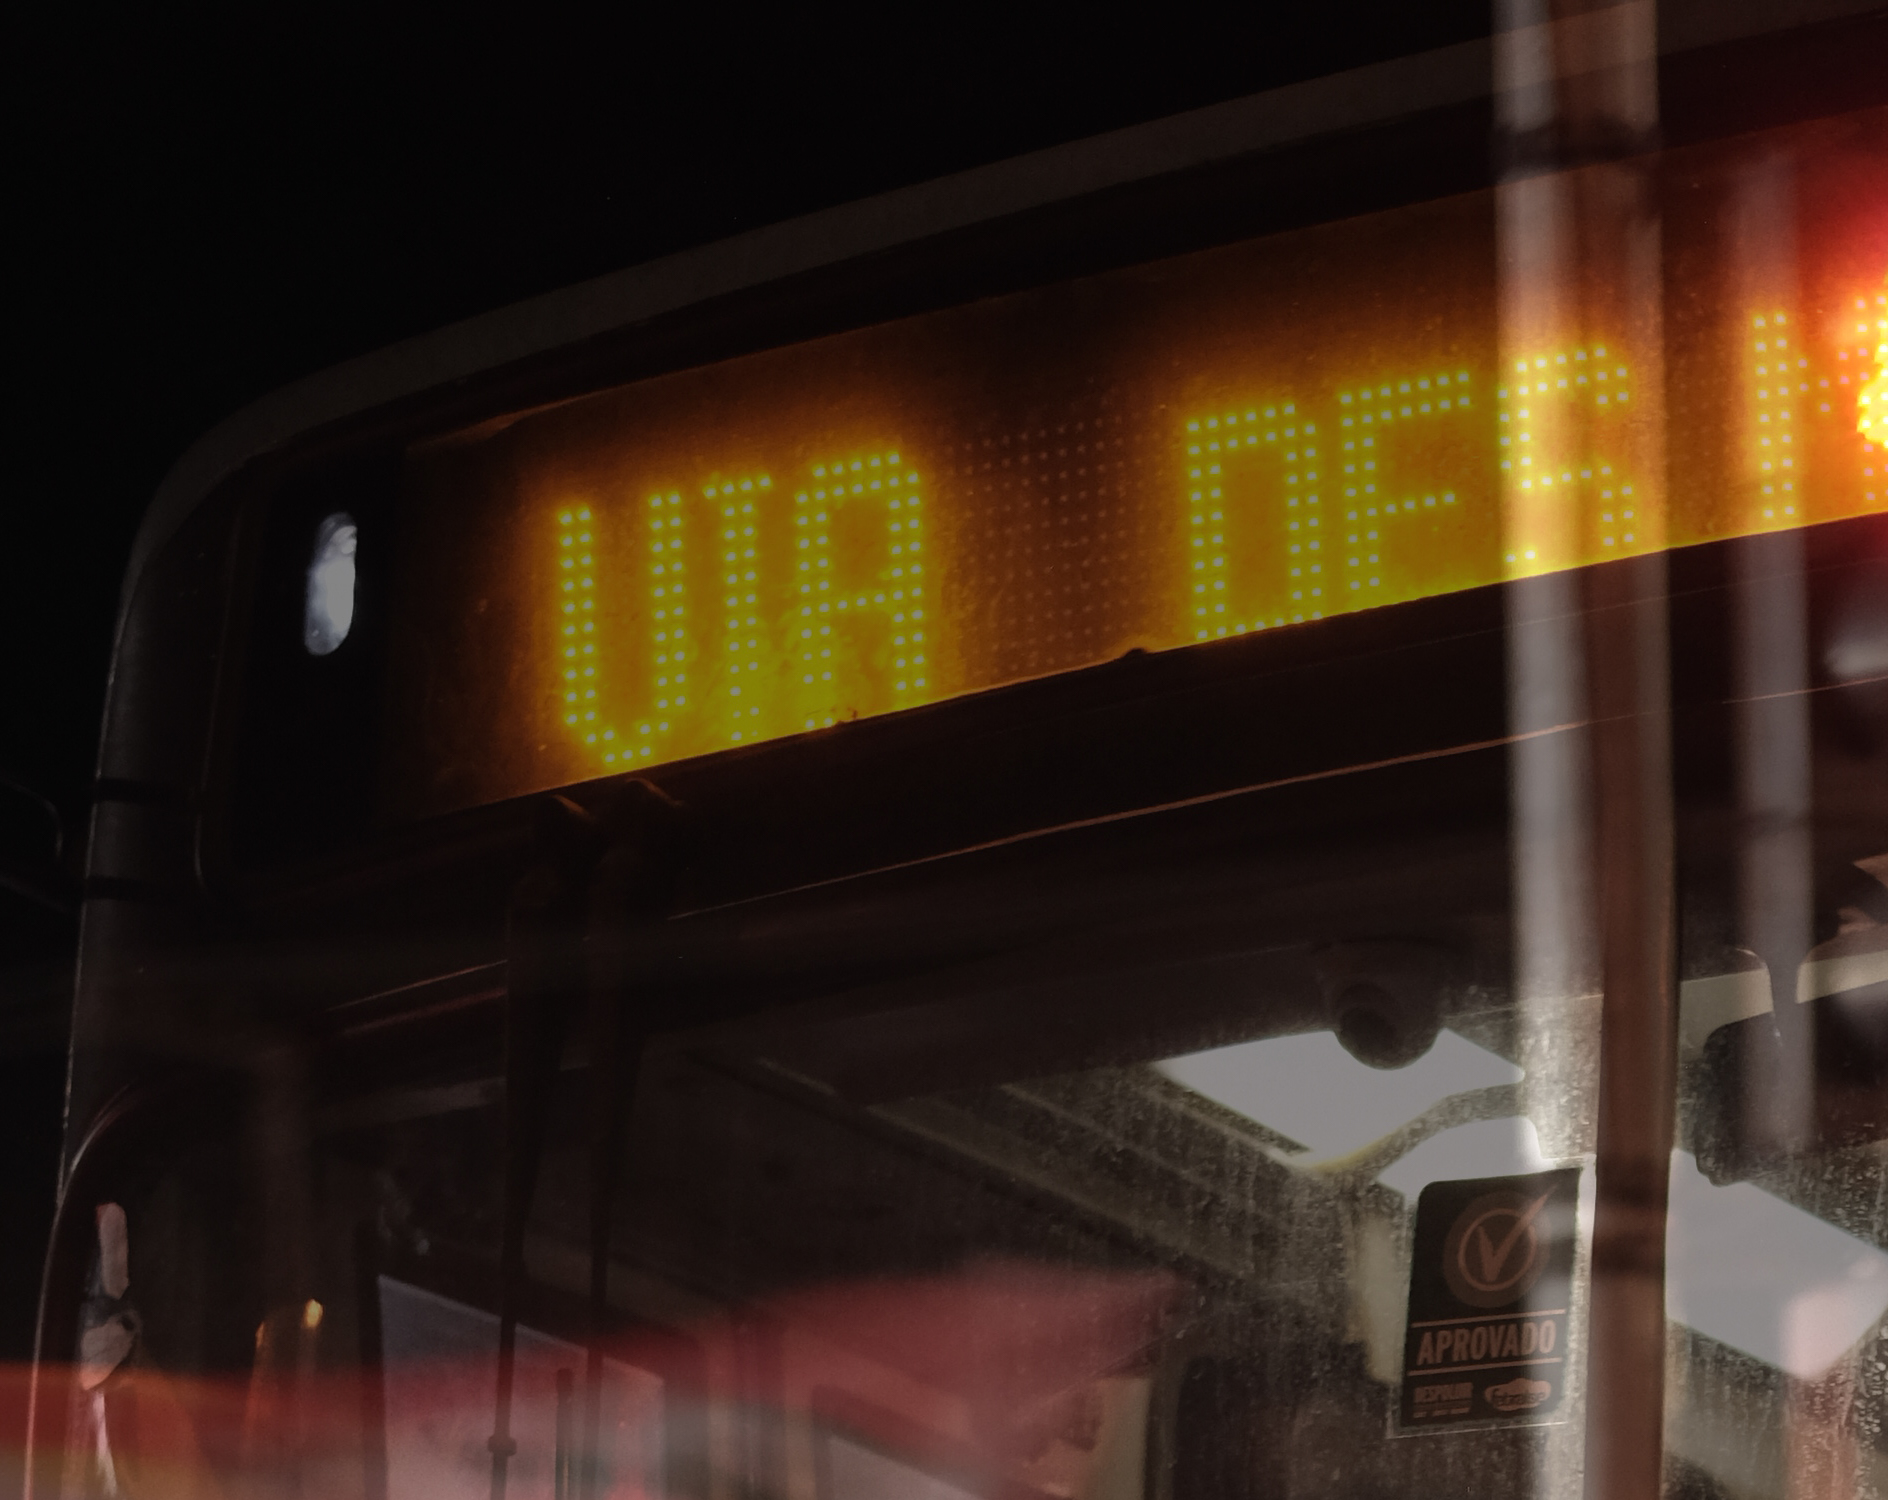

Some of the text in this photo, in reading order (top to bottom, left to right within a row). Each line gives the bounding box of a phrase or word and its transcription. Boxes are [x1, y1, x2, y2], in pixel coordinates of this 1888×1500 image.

[556, 446, 930, 770] VIA
[1184, 343, 1638, 642] DES
[1417, 1319, 1557, 1366] APROVADO
